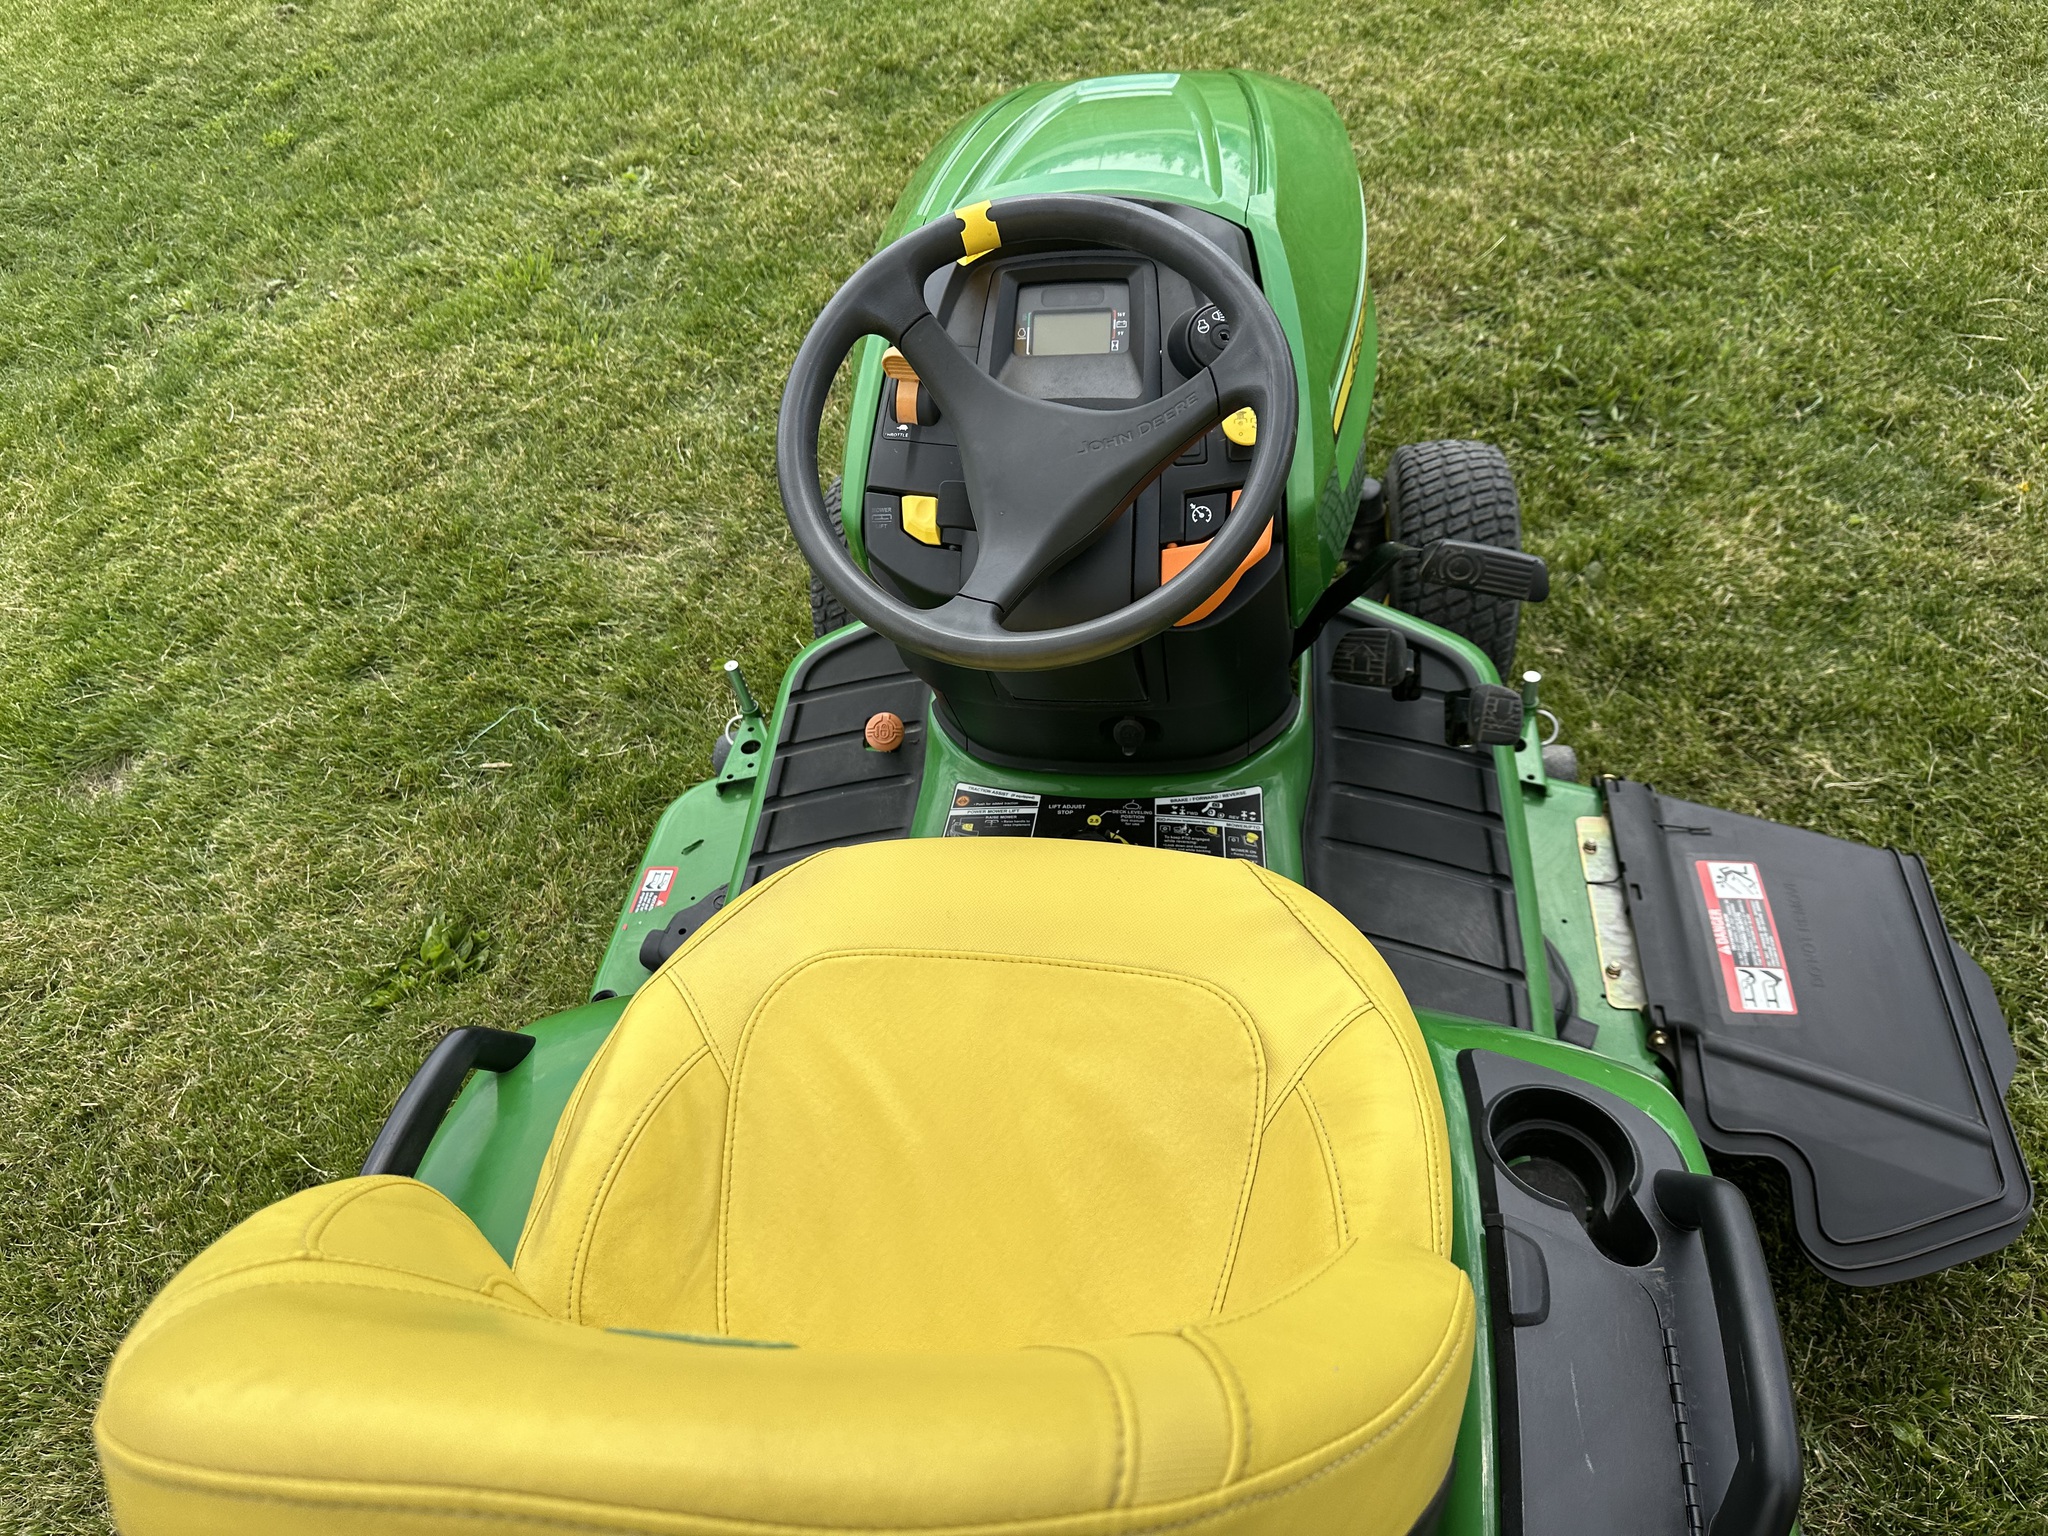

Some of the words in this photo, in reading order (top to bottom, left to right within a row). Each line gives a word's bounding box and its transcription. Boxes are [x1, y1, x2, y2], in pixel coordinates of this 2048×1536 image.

[1077, 431, 1133, 455] JOHN
[1137, 391, 1198, 437] DEERE
[968, 786, 992, 794] TRACTION
[1708, 908, 1730, 945] DANGER
